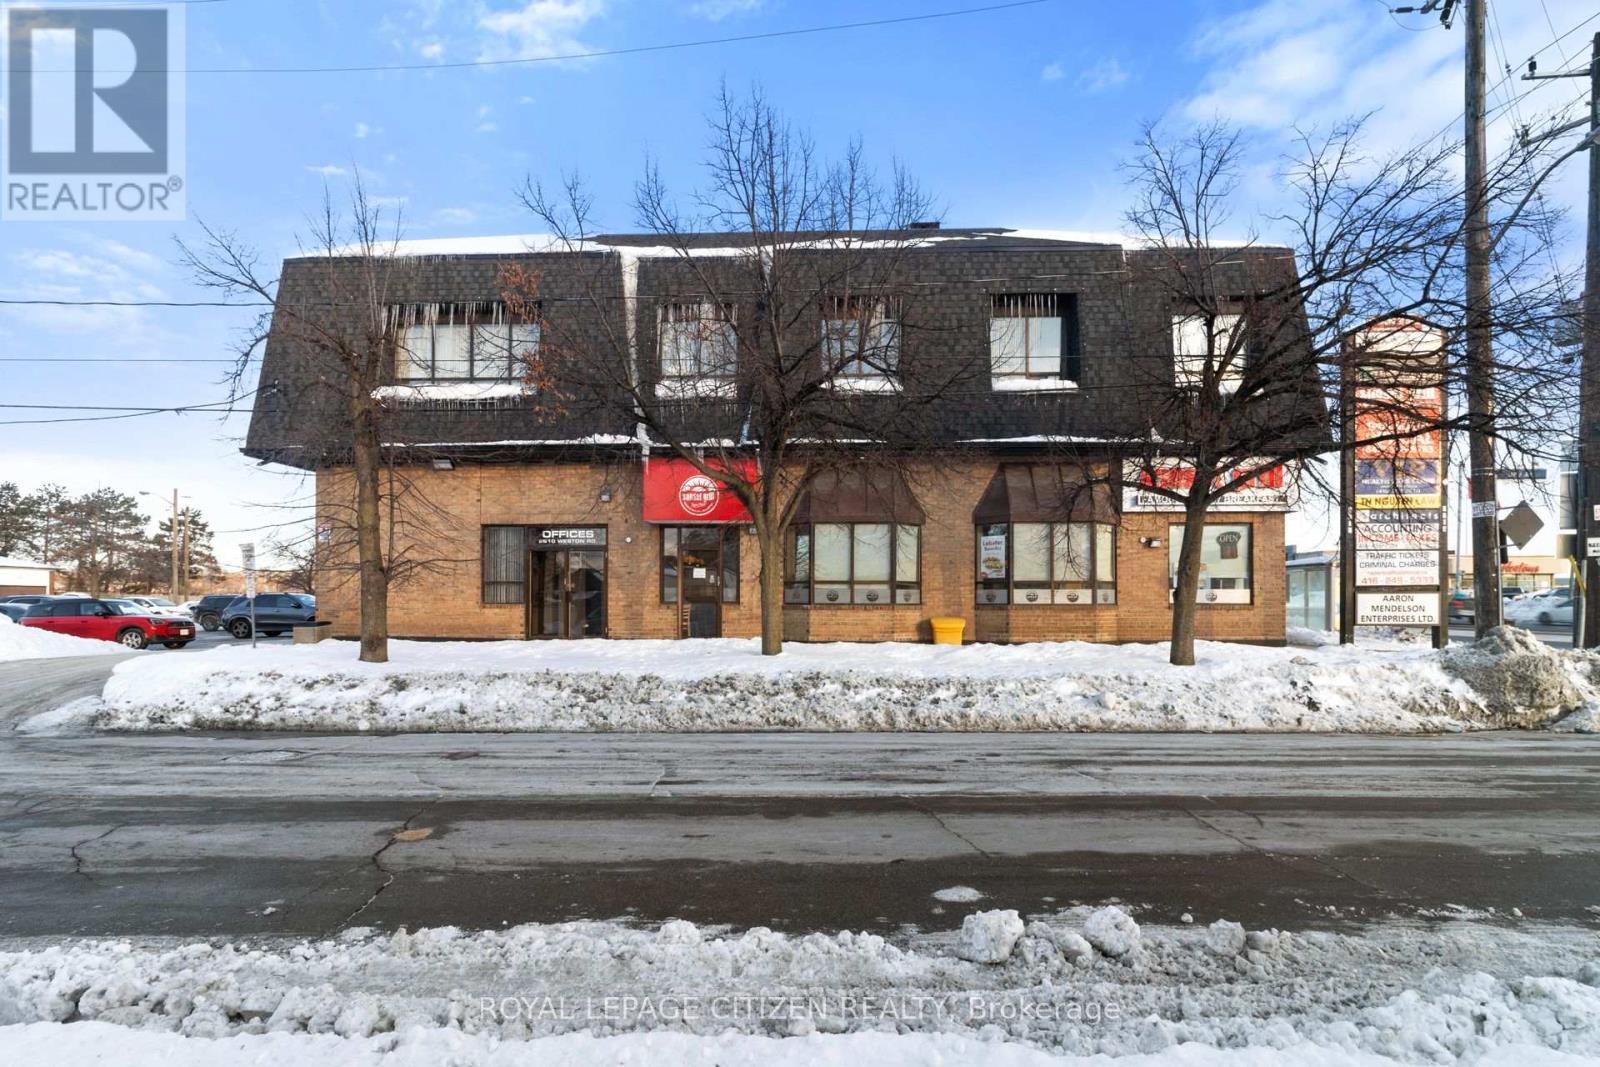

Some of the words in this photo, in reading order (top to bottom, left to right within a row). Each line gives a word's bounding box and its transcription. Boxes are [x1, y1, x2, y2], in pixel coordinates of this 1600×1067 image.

[1364, 524, 1432, 532] ACCOUNTING
[542, 530, 594, 538] OFFICES
[1220, 534, 1239, 542] OPEN
[1383, 594, 1414, 602] AARON
